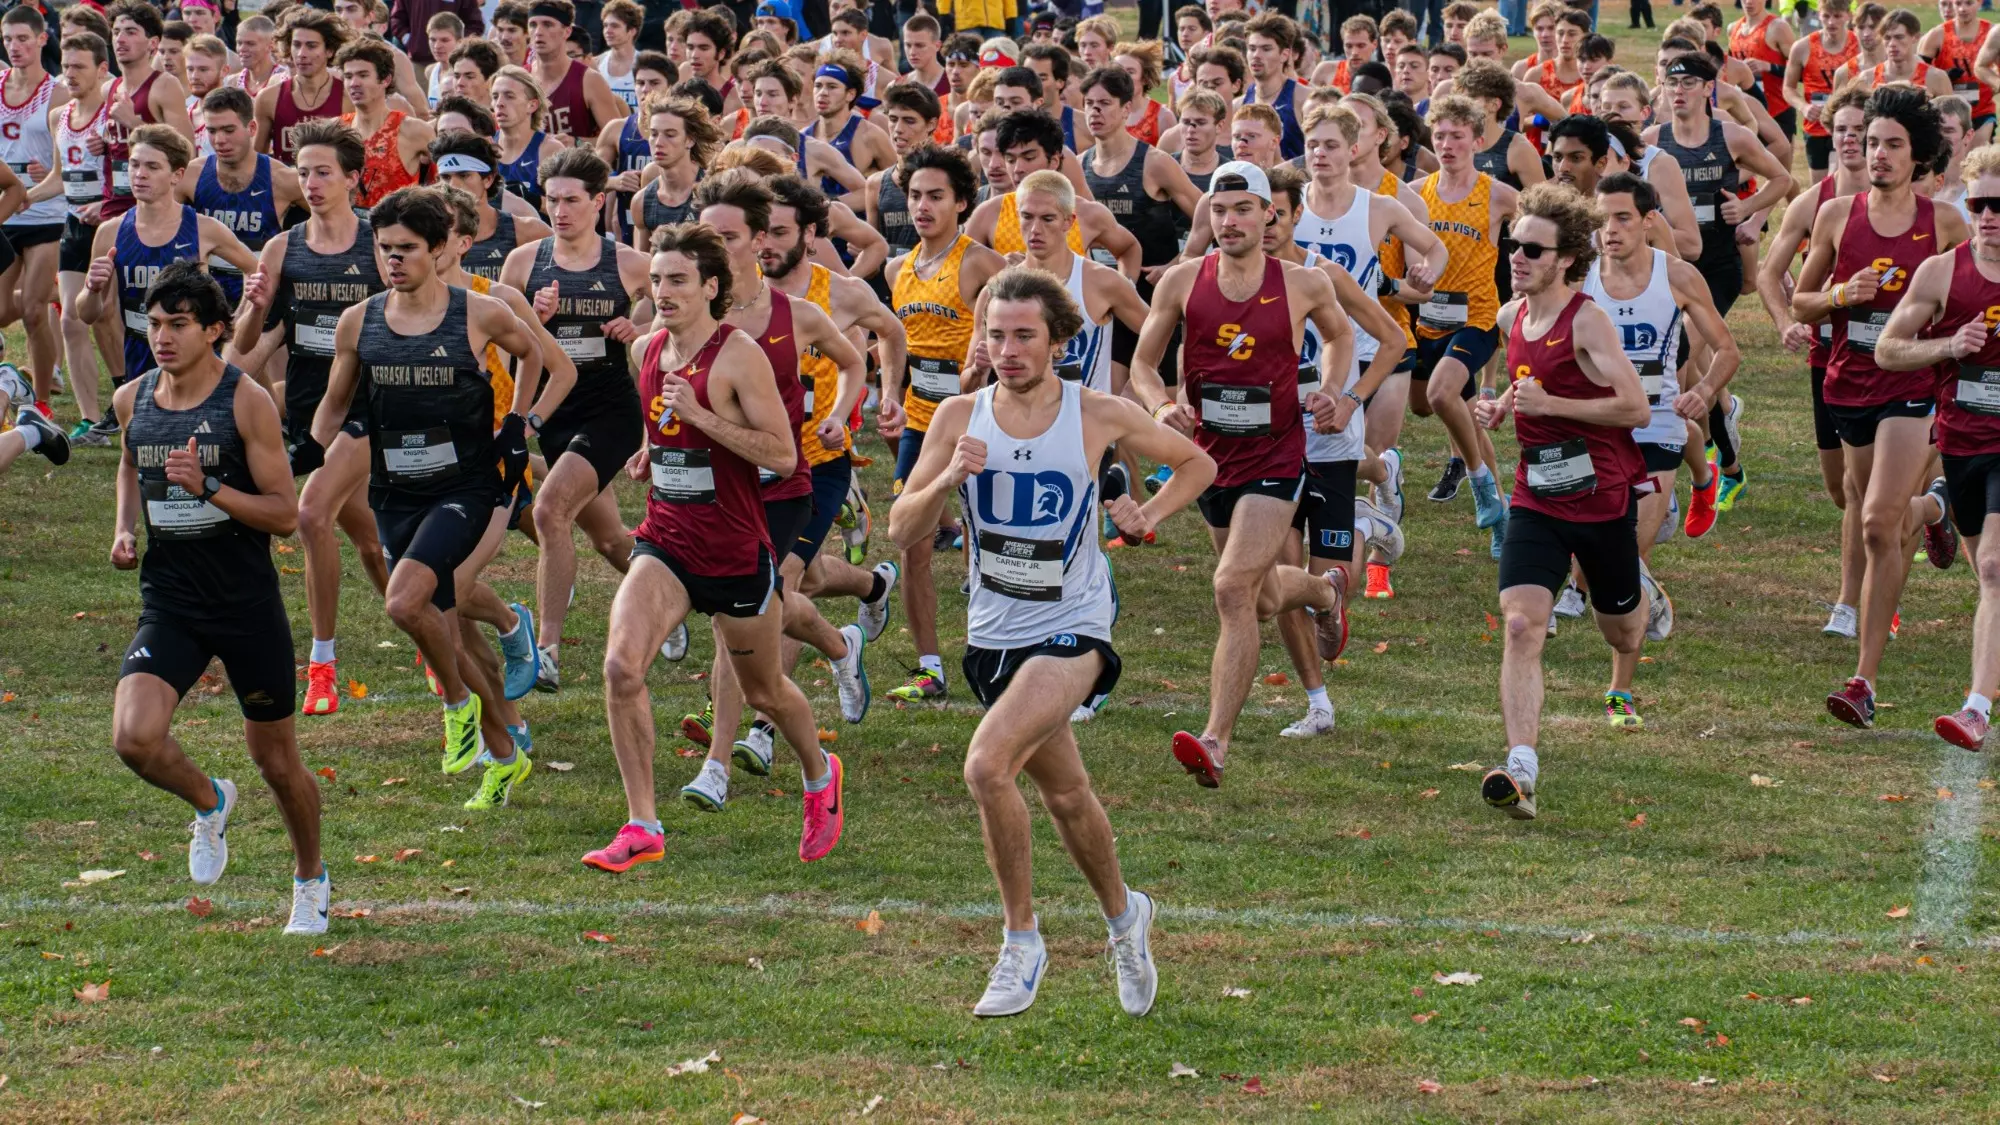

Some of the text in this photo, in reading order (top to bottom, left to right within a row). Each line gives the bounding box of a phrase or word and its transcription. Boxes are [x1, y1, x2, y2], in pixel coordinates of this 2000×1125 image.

[67, 145, 82, 164] C
[576, 299, 615, 316] WESLEYAN
[926, 302, 959, 320] VISTA
[1216, 323, 1256, 361] SC
[371, 365, 455, 386] NEBRASKA WESLEYAN
[403, 449, 430, 457] KNISPEL
[661, 467, 689, 476] LEGGETT
[163, 502, 204, 510] CHOJOLAN
[976, 469, 1075, 527] UD
[1003, 540, 1037, 550] AMERICAN
[995, 557, 1042, 570] CARNEY JR.
